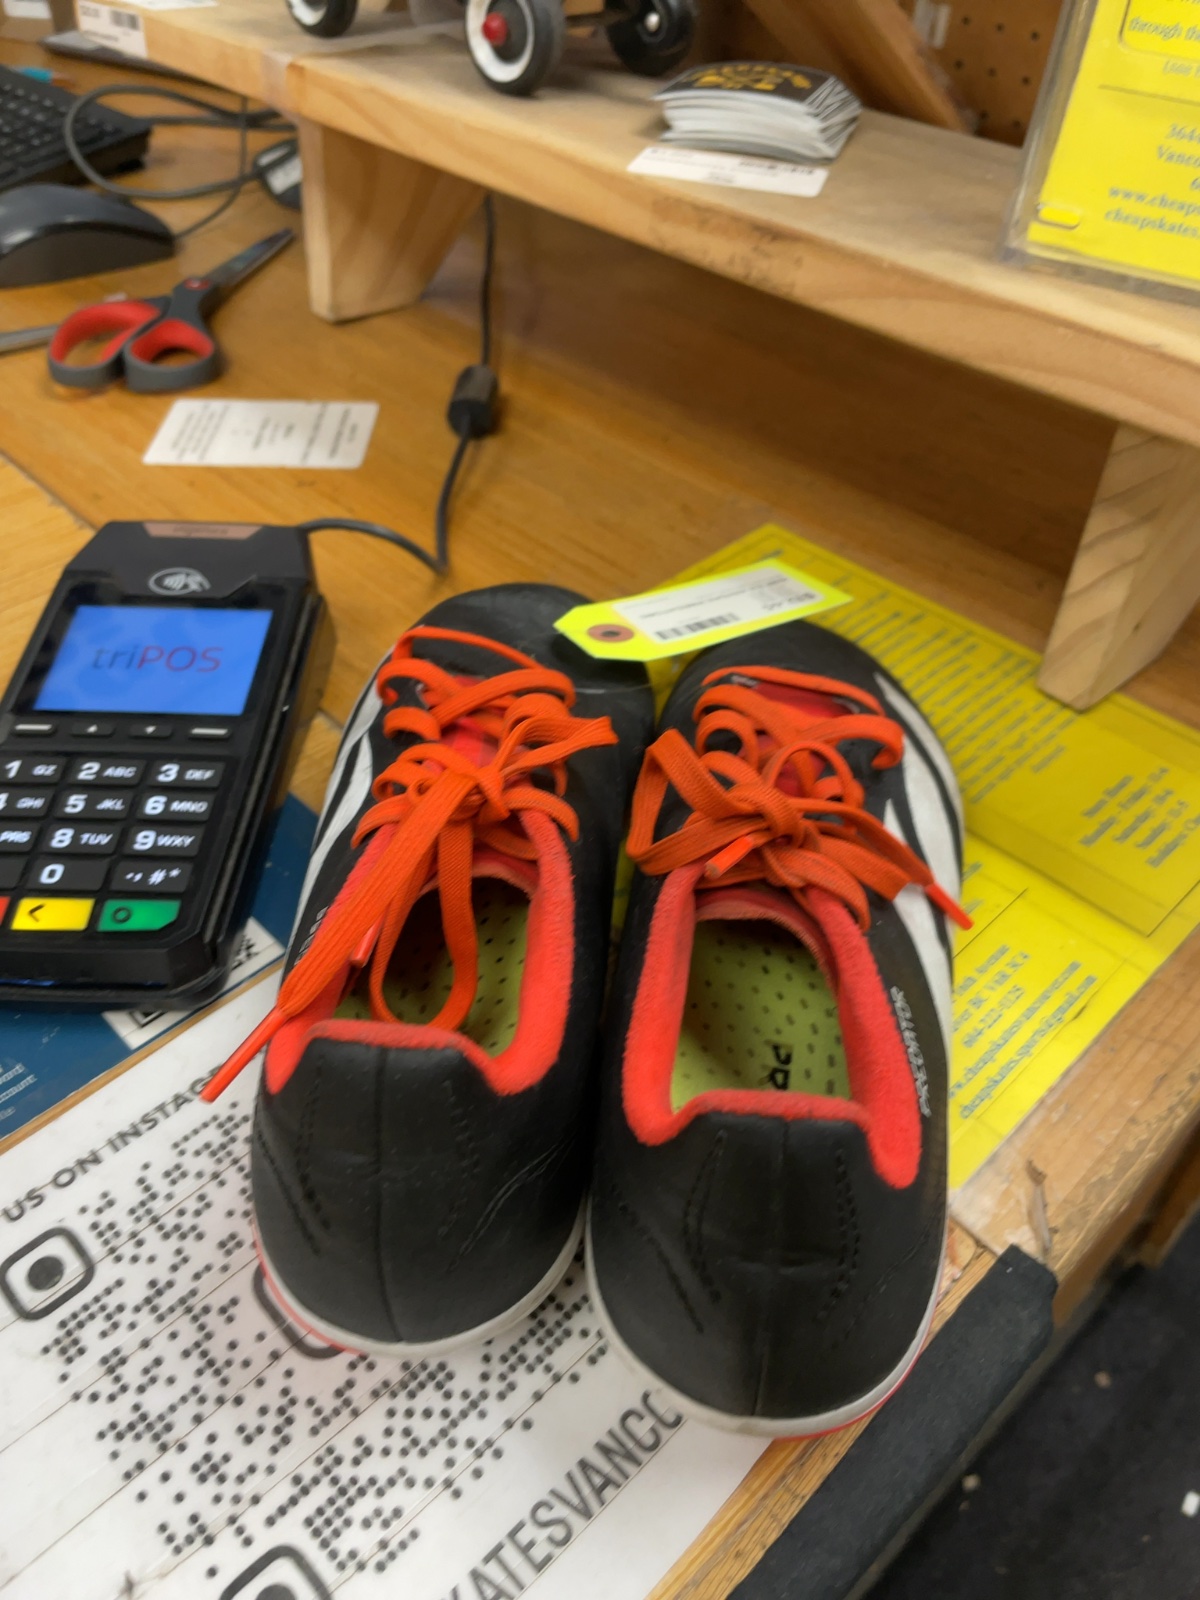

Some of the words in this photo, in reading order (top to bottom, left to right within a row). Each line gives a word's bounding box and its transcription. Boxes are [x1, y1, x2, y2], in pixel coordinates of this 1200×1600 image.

[91, 645, 223, 672] triPOS
[5, 760, 22, 778] 1
[77, 762, 101, 780] 2
[103, 766, 137, 778] ABC
[157, 763, 180, 782] 3
[184, 768, 215, 780] DEF
[64, 794, 88, 813] 5
[96, 799, 125, 810] JKL
[143, 796, 168, 815] 6
[169, 800, 209, 813] MNO
[50, 828, 75, 848] 8
[79, 832, 113, 845] TUV
[132, 830, 157, 850] 9
[157, 834, 196, 847] WXY
[39, 863, 65, 884] 0
[2, 1186, 46, 1222] US
[51, 1149, 103, 1189] ON
[107, 1063, 222, 1154] INSTAG
[440, 1389, 684, 1600] ATESVANC
